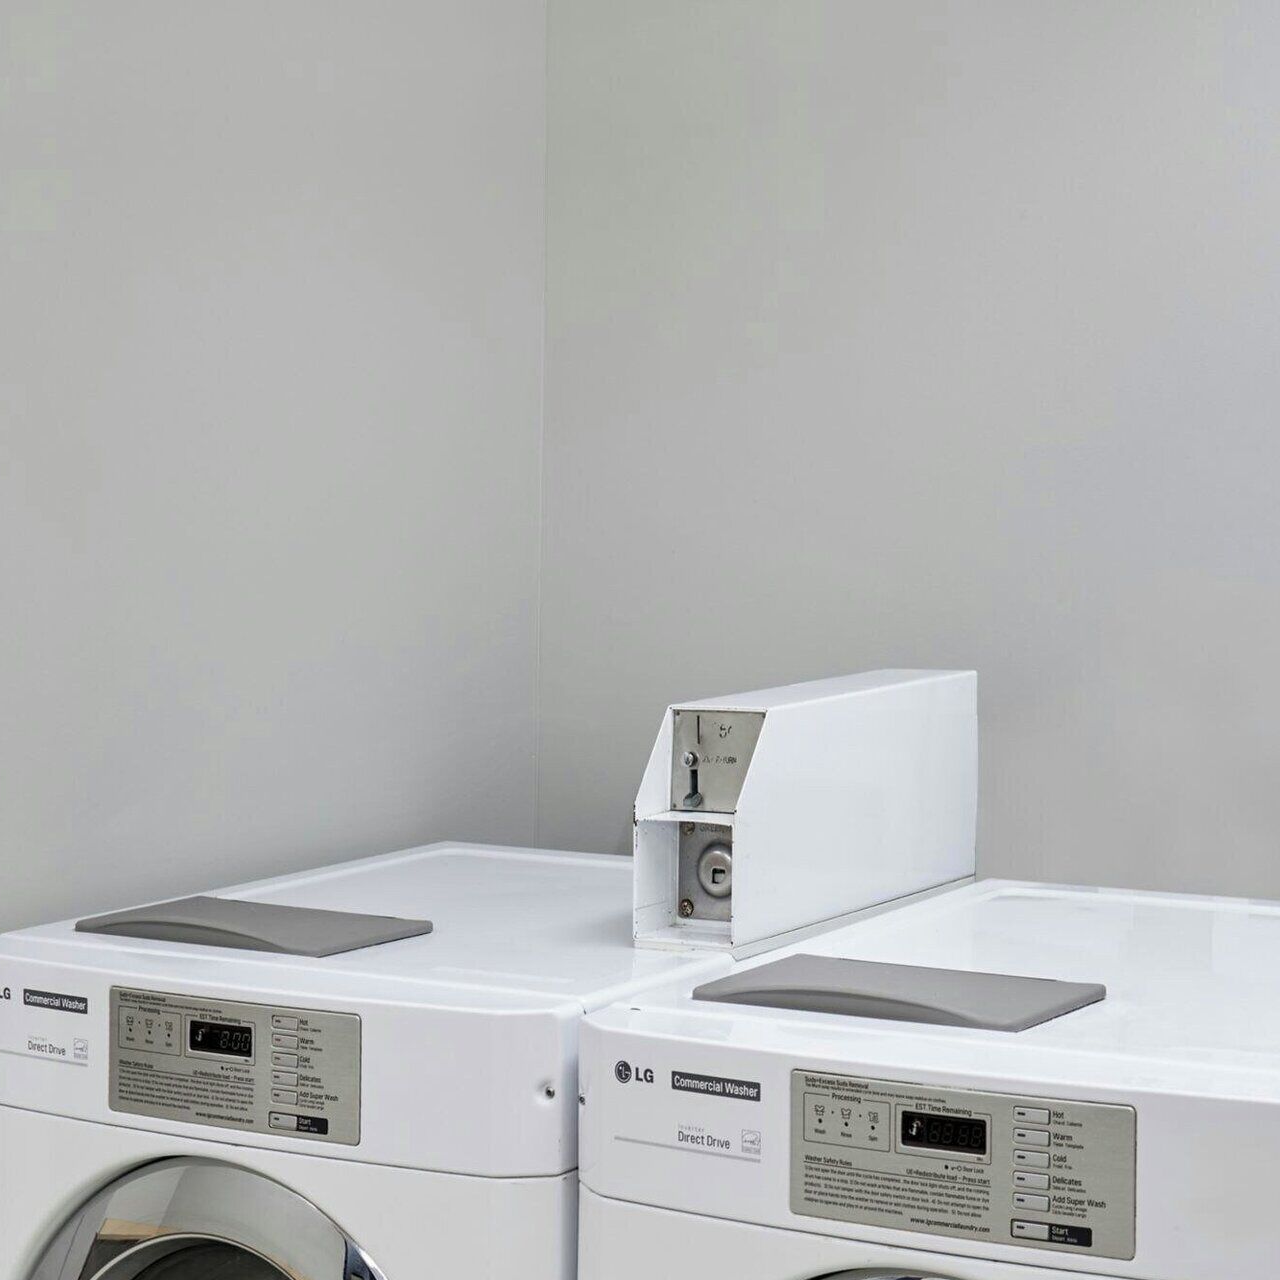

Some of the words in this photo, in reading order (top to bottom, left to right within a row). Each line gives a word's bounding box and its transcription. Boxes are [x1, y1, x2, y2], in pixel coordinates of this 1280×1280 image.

[25, 993, 60, 1007] Commercial
[61, 999, 86, 1010] Washer
[28, 1040, 47, 1053] Direct
[49, 1044, 66, 1056] Drive
[635, 1067, 654, 1083] LG
[674, 1075, 723, 1093] Commercial
[725, 1083, 758, 1097] Washer
[832, 1093, 862, 1103] Processing
[915, 1102, 926, 1111] EST
[928, 1104, 941, 1112] Time
[942, 1106, 972, 1117] Remaining
[1053, 1111, 1064, 1119] Hot
[678, 1131, 705, 1146] Direct
[706, 1135, 730, 1150] Drive
[1053, 1133, 1072, 1141] Warm
[1053, 1154, 1067, 1162] Cold
[962, 1175, 976, 1183] Press
[1052, 1176, 1082, 1186] Delicates
[1052, 1195, 1065, 1203] Add
[1066, 1197, 1085, 1206] Super
[1087, 1199, 1106, 1209] Wash
[1051, 1226, 1068, 1236] Start
